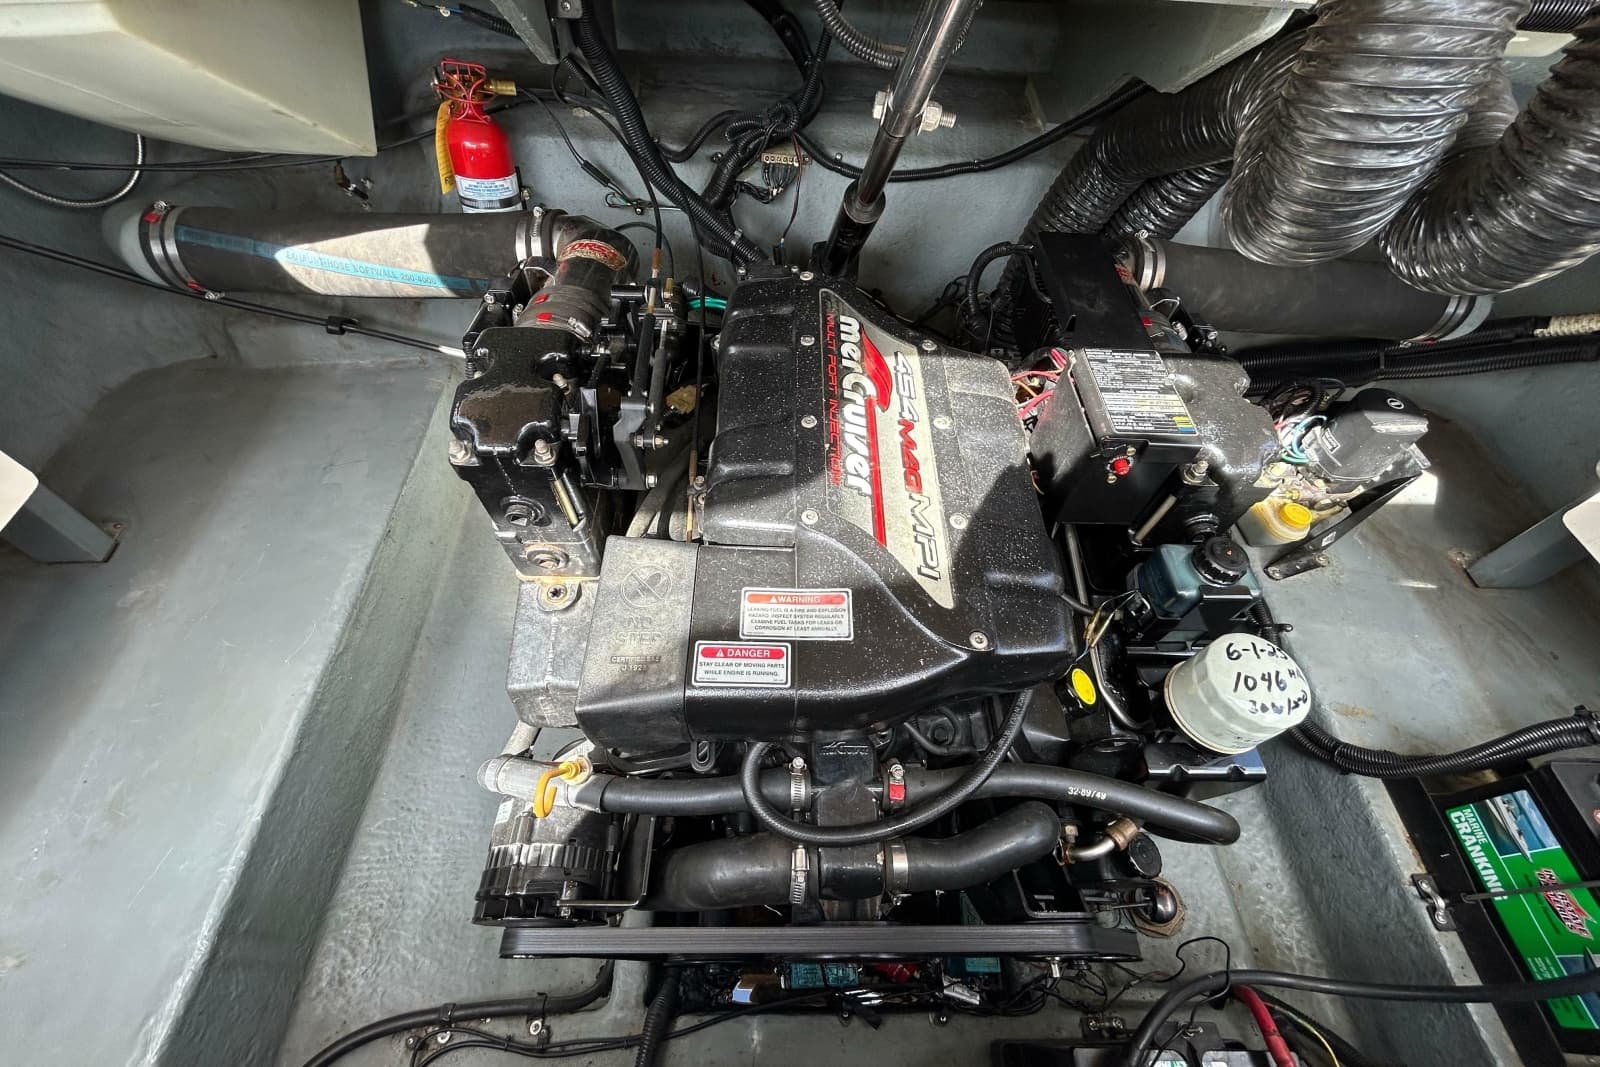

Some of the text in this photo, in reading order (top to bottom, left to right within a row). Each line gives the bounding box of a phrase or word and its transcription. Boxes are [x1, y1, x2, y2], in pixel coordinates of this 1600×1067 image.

[825, 313, 842, 486] MULTI PORT INJECTION
[894, 351, 941, 581] 454 MAG MPI
[777, 595, 821, 604] WARNING
[727, 649, 770, 657] DANGER
[1233, 670, 1287, 693] 1046
[1462, 808, 1488, 845] MARINE
